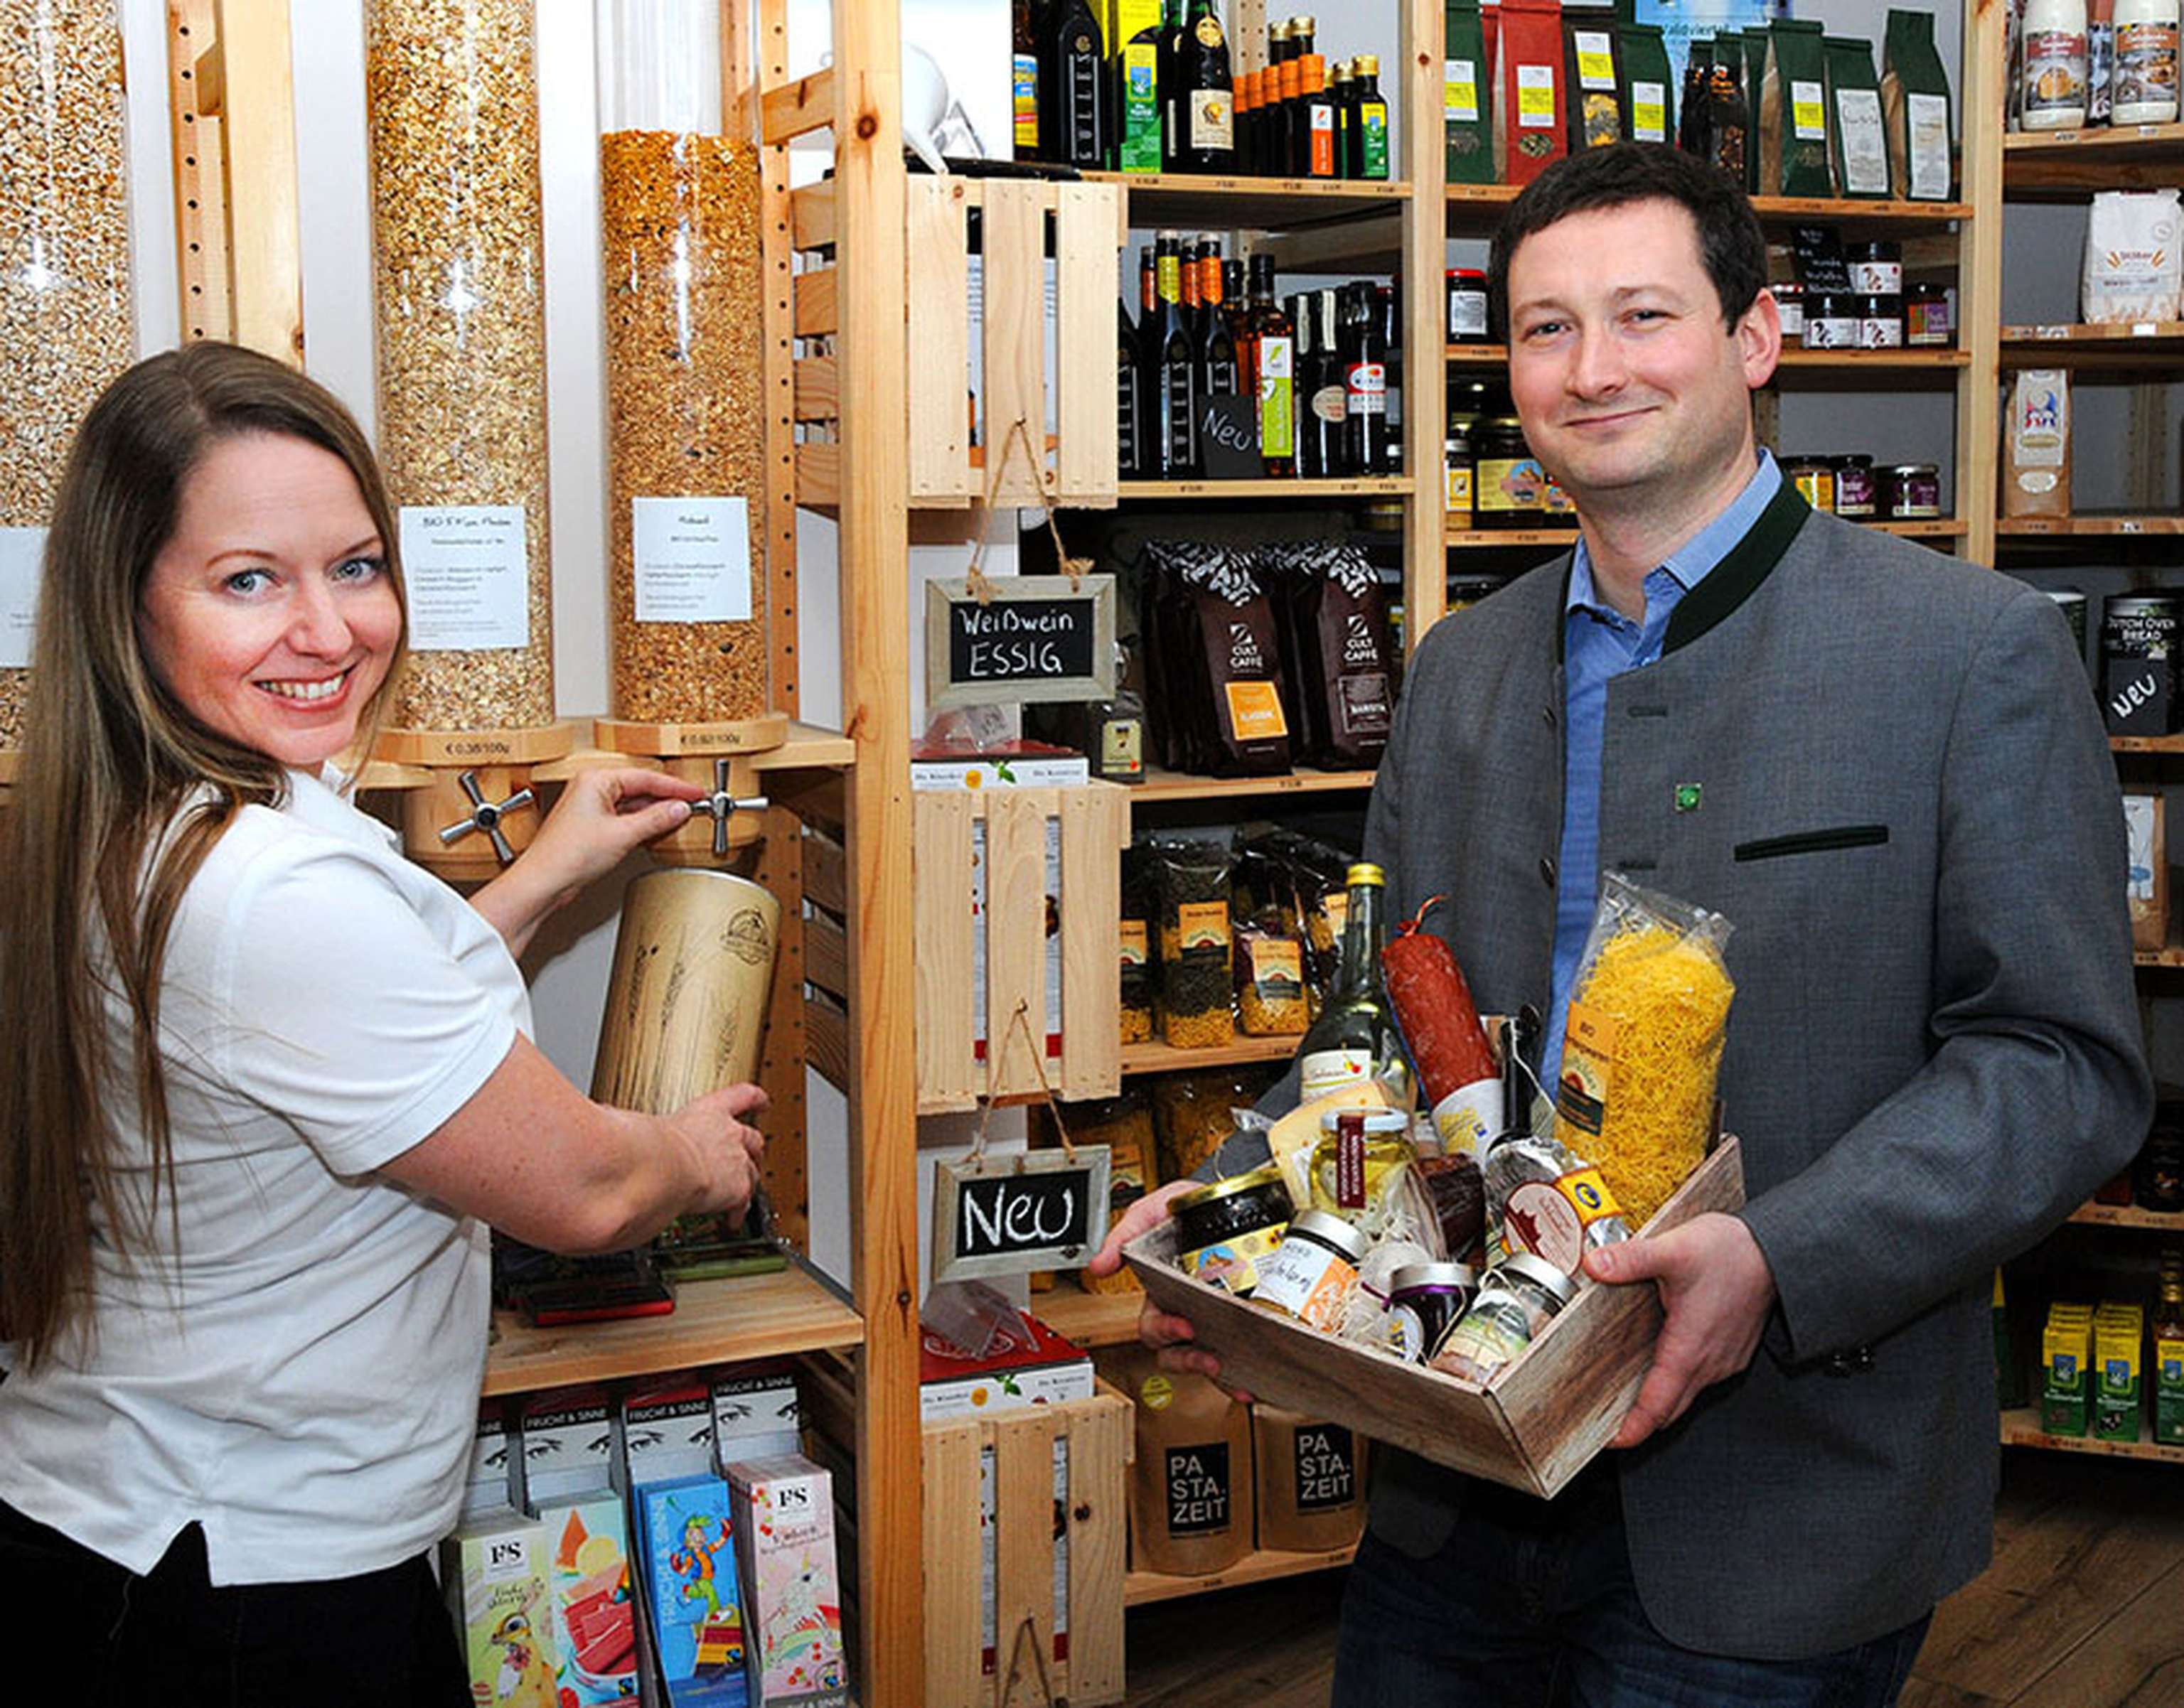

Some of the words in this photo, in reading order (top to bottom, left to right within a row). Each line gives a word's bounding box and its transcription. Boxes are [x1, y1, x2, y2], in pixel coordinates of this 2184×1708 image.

[1201, 407, 1252, 451] Neu
[959, 608, 1074, 635] Weißwein
[969, 641, 1063, 677] ESSIG
[965, 1183, 1073, 1250] Neu
[1298, 1433, 1330, 1454] PA
[1171, 1456, 1204, 1478] PA
[1301, 1474, 1350, 1500] ZEIT
[1173, 1497, 1226, 1524] ZEIT
